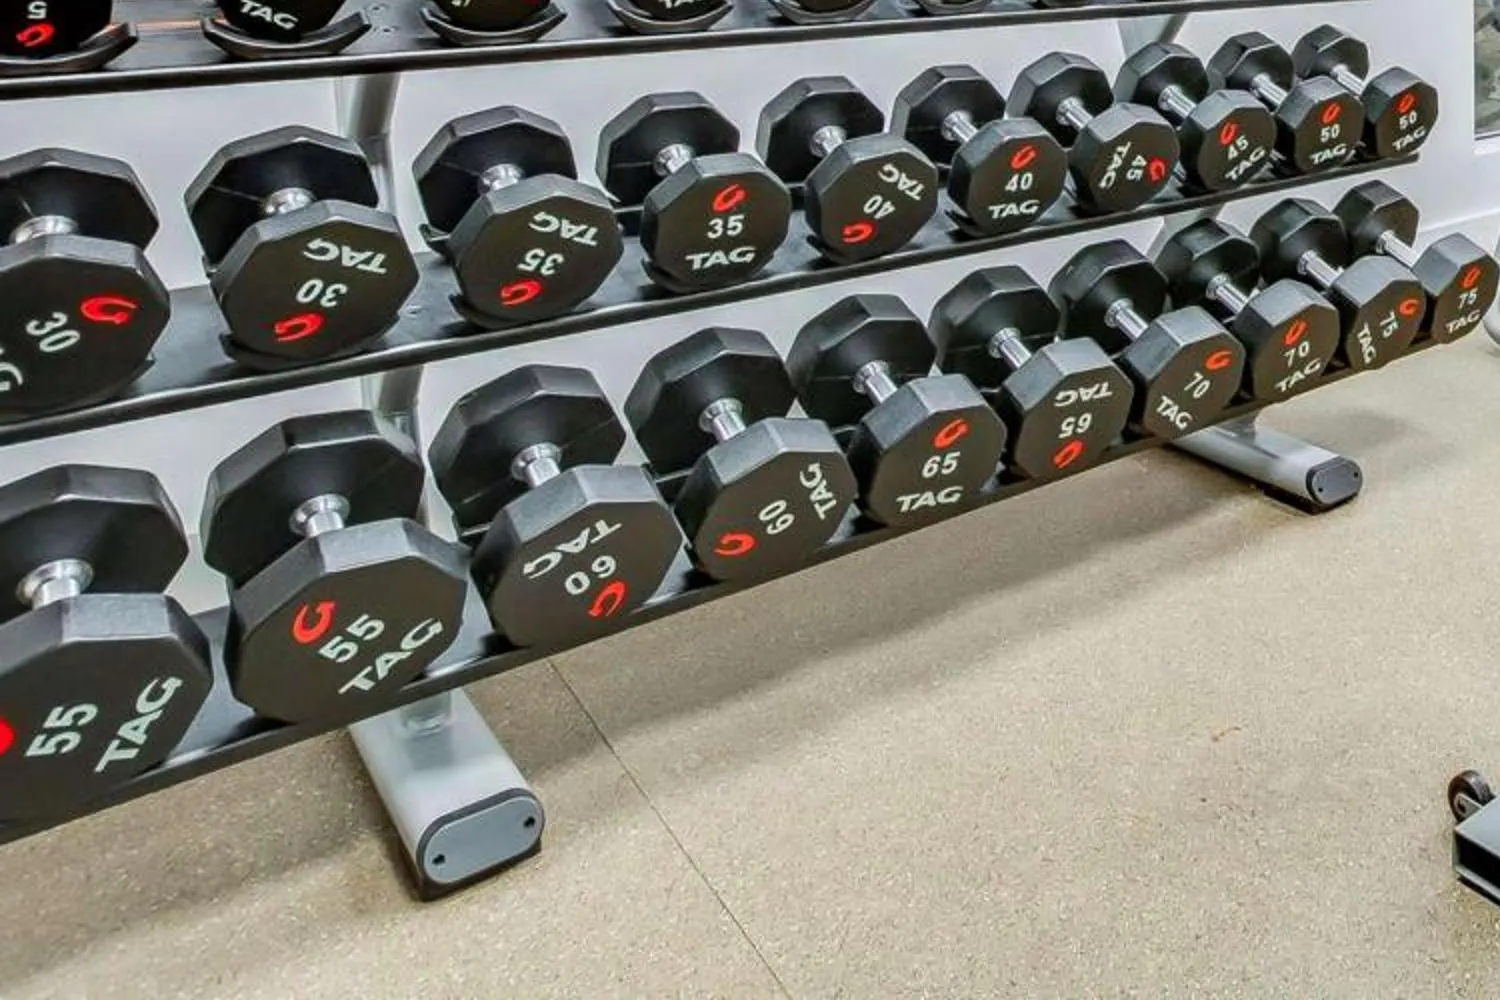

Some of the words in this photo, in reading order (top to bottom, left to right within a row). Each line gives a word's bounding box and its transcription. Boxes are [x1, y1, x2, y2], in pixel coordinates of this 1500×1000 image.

[27, 0, 47, 20] 5
[1320, 123, 1341, 143] 50
[1399, 110, 1418, 130] 50
[1227, 135, 1249, 160] 45
[1392, 126, 1426, 151] TAG
[1099, 141, 1132, 189] TAG
[1125, 154, 1147, 181] 45
[1225, 147, 1266, 181] TAG
[1310, 143, 1347, 165] TAG
[878, 163, 924, 201] TAG
[1004, 172, 1033, 192] 40
[863, 194, 896, 219] 40
[988, 199, 1039, 219] TAG
[528, 211, 598, 246] TAG
[707, 214, 745, 239] 35
[303, 237, 387, 274] TAG
[517, 248, 565, 276] 35
[685, 245, 755, 270] TAG
[296, 278, 348, 308] 30
[1458, 289, 1478, 310] 75
[25, 311, 81, 353] 30
[1379, 311, 1399, 338] 75
[1446, 309, 1481, 334] TAG
[1284, 340, 1310, 367] 70
[1357, 322, 1377, 364] TAG
[1183, 371, 1211, 399] 70
[1275, 358, 1321, 392] TAG
[1054, 381, 1113, 407] TAG
[1058, 412, 1093, 439] 65
[1156, 395, 1192, 430] TAG
[922, 451, 961, 478] 65
[799, 462, 837, 520] TAG
[896, 485, 963, 513] TAG
[758, 499, 795, 535] 60
[522, 519, 622, 579] TAG
[564, 555, 617, 595] 60
[318, 613, 385, 663] 55
[338, 618, 443, 694] TAG
[25, 703, 98, 757] 55
[94, 676, 183, 774] TAG
